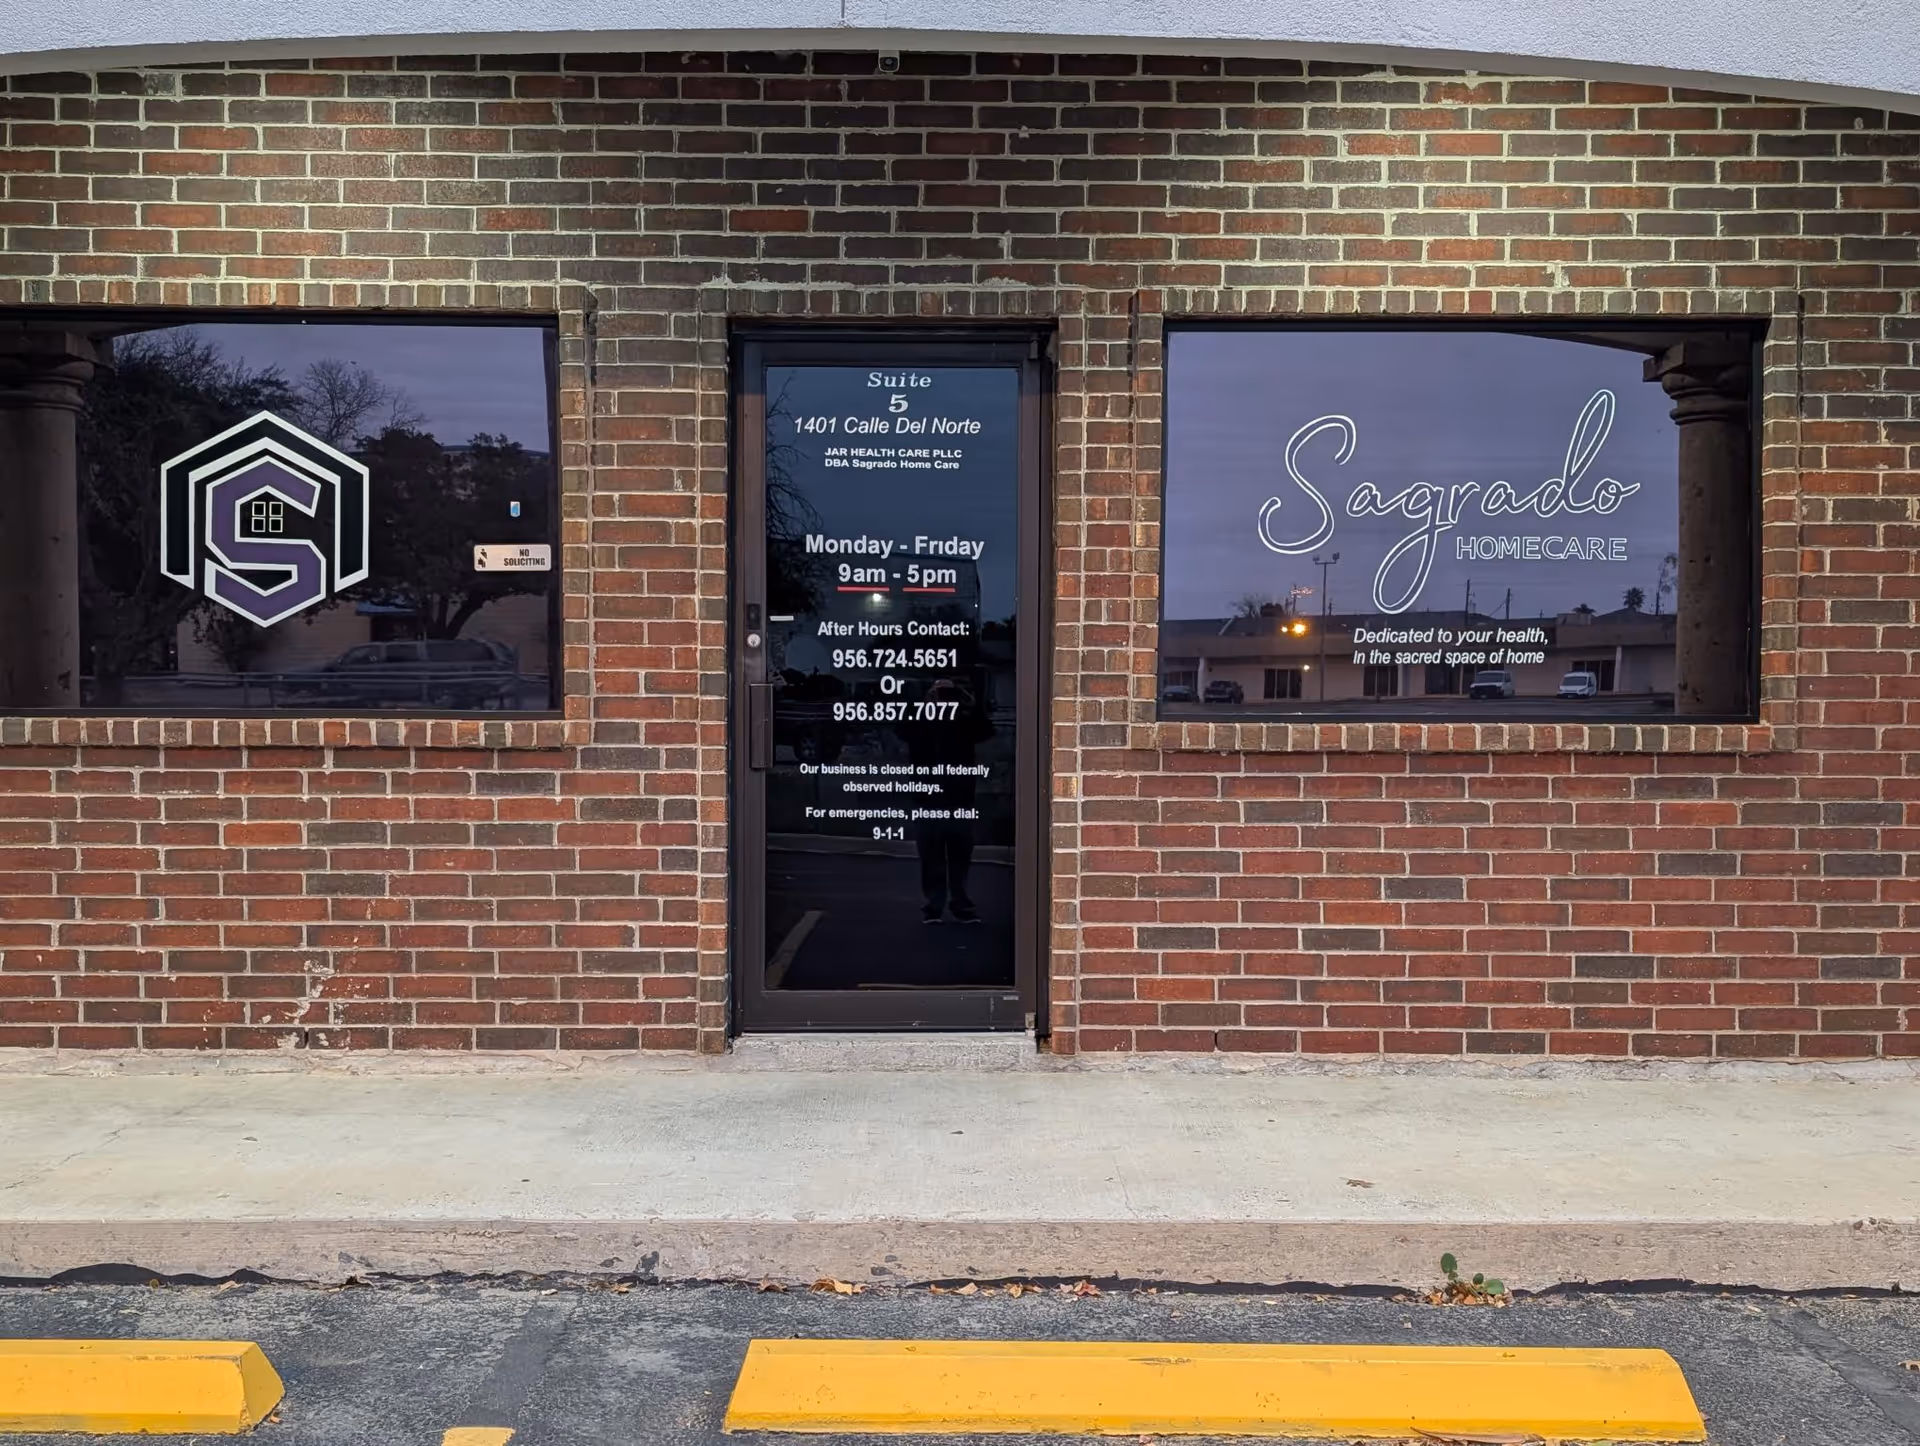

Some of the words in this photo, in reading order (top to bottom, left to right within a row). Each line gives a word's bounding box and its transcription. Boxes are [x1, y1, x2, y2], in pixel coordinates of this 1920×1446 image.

[867, 371, 932, 388] Suite
[888, 393, 909, 413] 5
[793, 417, 837, 434] 1401
[844, 417, 890, 434] Calle
[895, 417, 926, 434] Del
[931, 417, 981, 435] Norte
[824, 448, 848, 457] JAR
[850, 448, 896, 458] HEALTH
[898, 448, 930, 458] CARE
[933, 449, 963, 459] PLLC
[824, 458, 849, 468] DBA
[852, 459, 898, 470] Sagrado
[900, 460, 932, 469] Home
[934, 460, 960, 470] Care
[1257, 388, 1641, 615] Sagrado
[519, 548, 530, 557] NO
[805, 534, 894, 559] Monday
[914, 535, 985, 560] Friday
[1455, 535, 1628, 562] HOMECARE
[503, 557, 546, 566] SOLICITING
[837, 563, 886, 583] 9am
[907, 564, 957, 588] 5pm
[817, 620, 854, 636] After
[858, 621, 903, 636] Hours
[907, 621, 970, 637] Contact:
[1353, 627, 1435, 644] Dedicated
[1437, 629, 1453, 644] to
[1455, 630, 1493, 646] your
[1496, 627, 1549, 646] health,
[832, 648, 958, 668] 956.724.5651
[1353, 649, 1366, 665] In
[1369, 649, 1391, 665] the
[1394, 649, 1441, 664] sacred
[1444, 651, 1486, 668] space
[1489, 648, 1505, 664] of
[1506, 649, 1545, 664] home
[879, 675, 905, 694] Or
[833, 702, 959, 722] 956.857.7077
[799, 763, 819, 774] Our
[821, 763, 867, 775] business
[869, 764, 878, 775] is
[880, 763, 914, 775] closed
[916, 765, 930, 775] on
[931, 763, 944, 776] all
[946, 764, 990, 778] federally
[842, 781, 893, 793] observed
[895, 781, 944, 795] holidays.
[805, 807, 827, 819] For
[828, 808, 909, 821] emergencies,
[911, 808, 951, 821] please
[953, 808, 980, 820] dial:
[872, 827, 905, 841] 9-1-1
